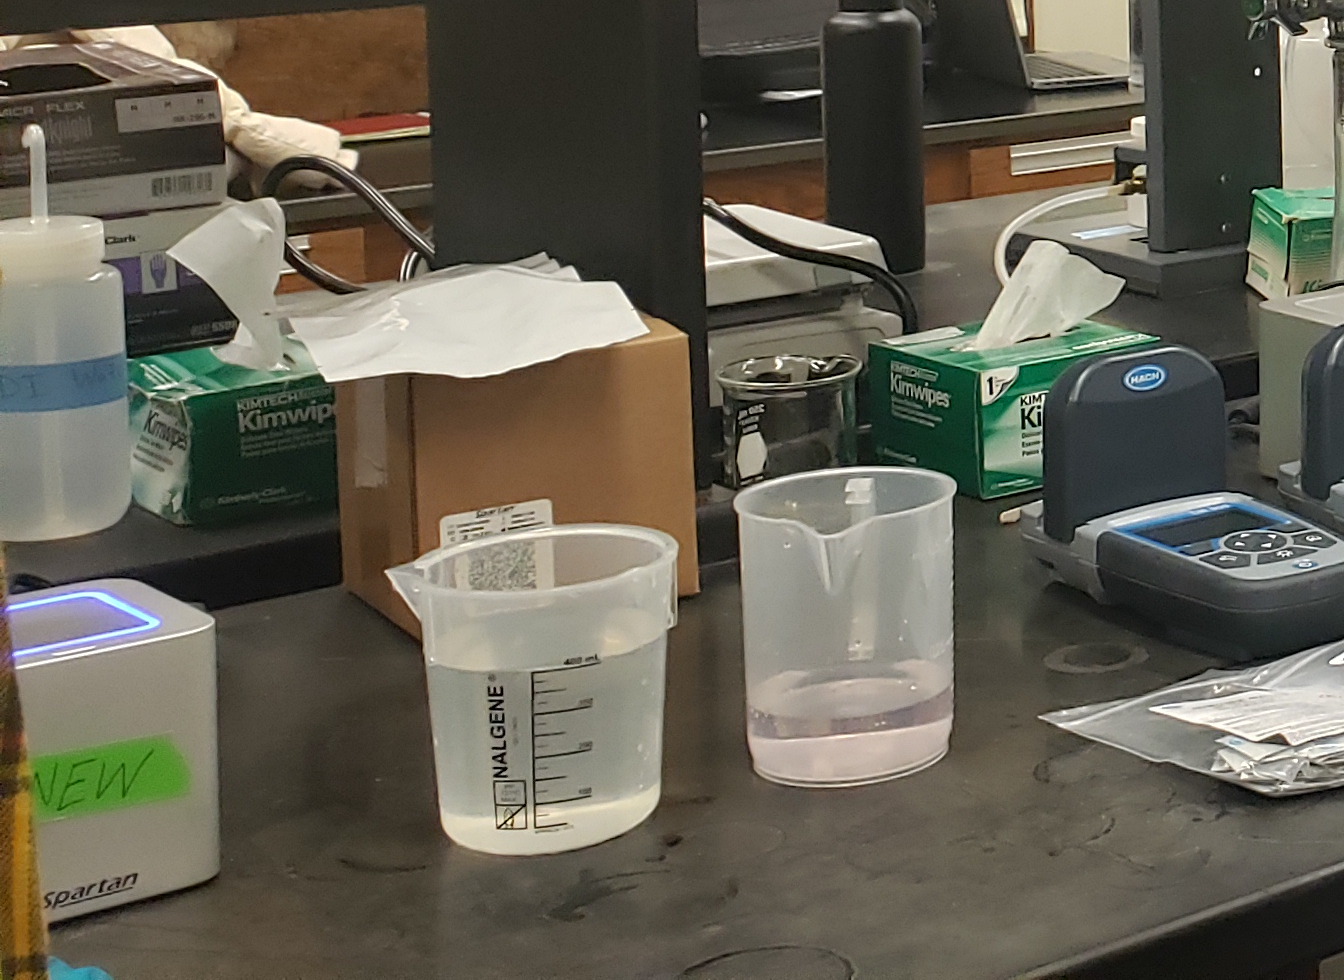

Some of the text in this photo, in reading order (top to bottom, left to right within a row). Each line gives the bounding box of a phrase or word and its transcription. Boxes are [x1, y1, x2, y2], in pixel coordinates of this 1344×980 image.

[890, 371, 951, 409] Kimwipes
[1130, 371, 1160, 384] HACH
[487, 685, 509, 779] NALGENE
